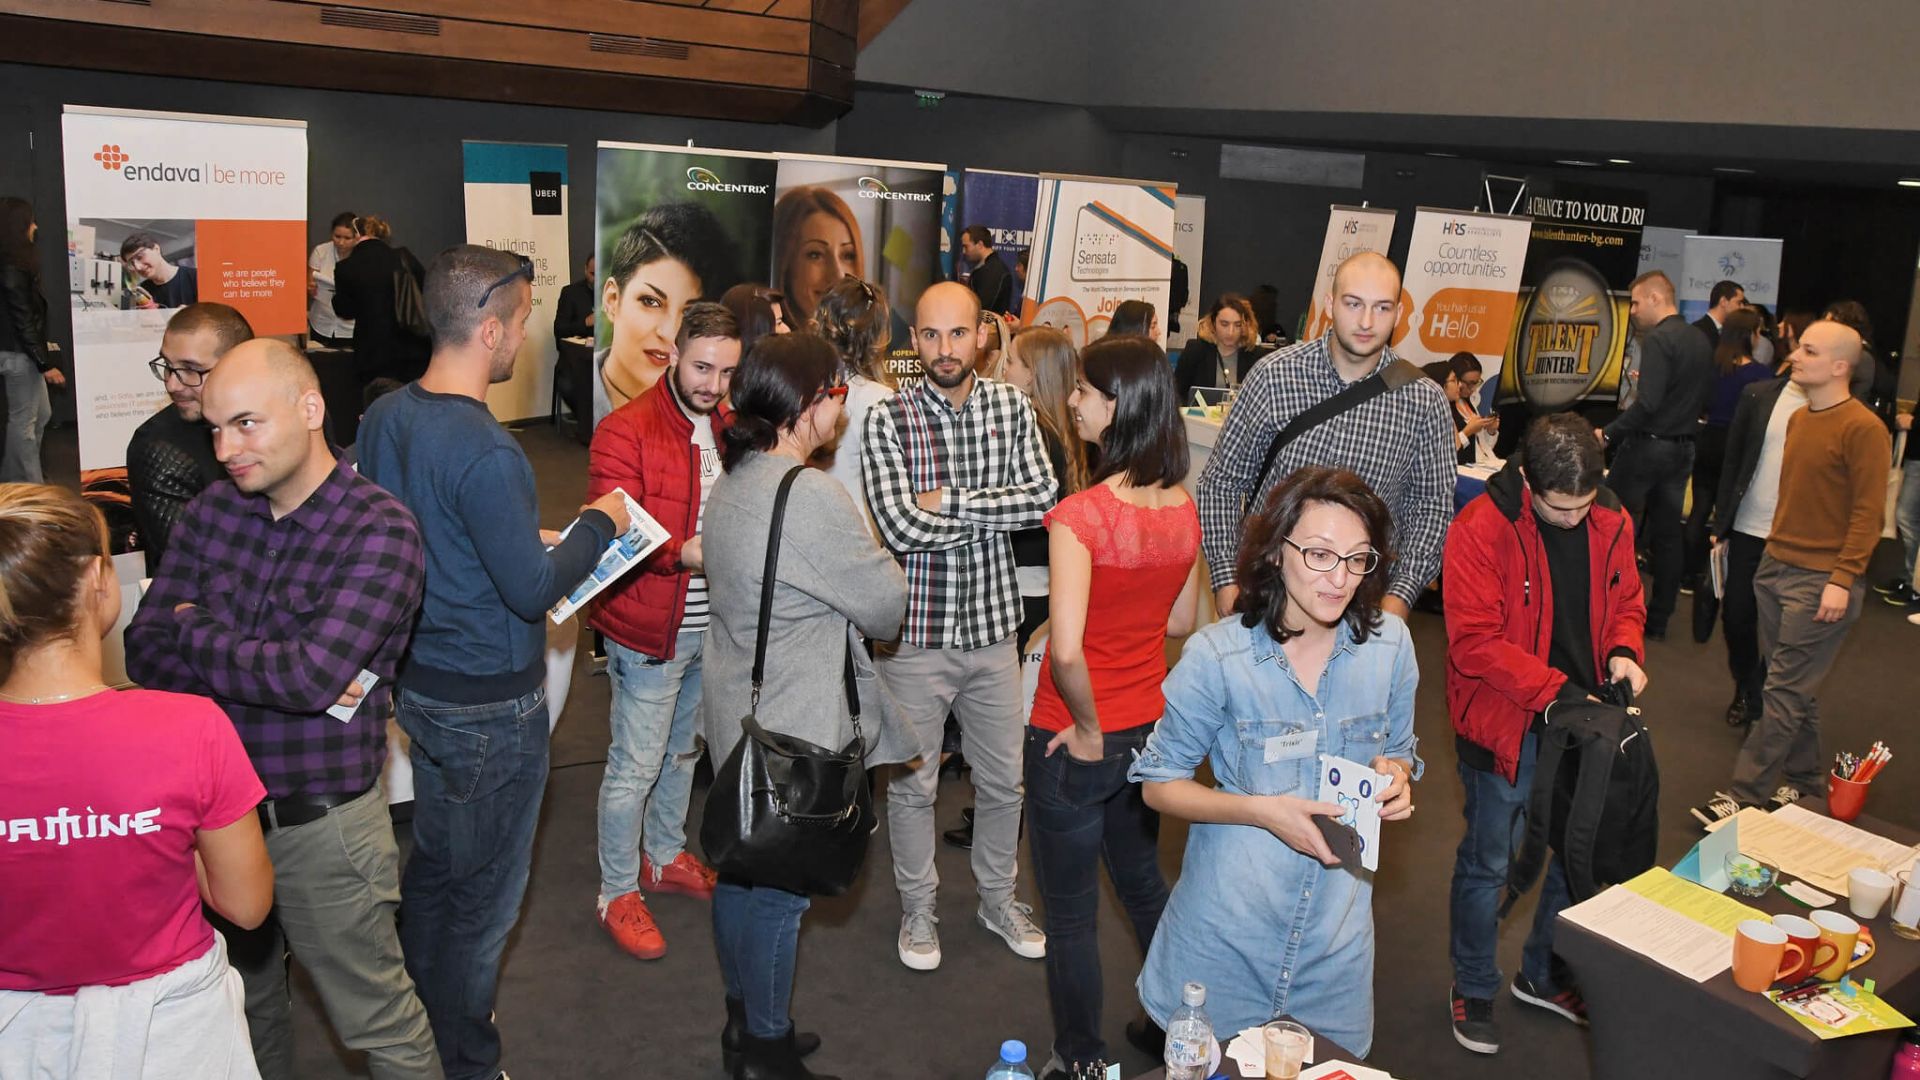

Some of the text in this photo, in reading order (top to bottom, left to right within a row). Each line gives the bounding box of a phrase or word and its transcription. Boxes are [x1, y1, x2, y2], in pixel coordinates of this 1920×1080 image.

[124, 163, 285, 185] endava be more
[535, 189, 557, 198] UBER
[687, 182, 768, 194] CONCENTRIX
[858, 190, 933, 202] CONCENTRIX
[1527, 197, 1645, 226] A CHANCE TO YOUR DRI
[1078, 250, 1117, 265] Sensata
[1439, 242, 1498, 262] Countless
[251, 268, 277, 278] people
[1424, 260, 1507, 278] opportunities
[223, 279, 285, 288] who believe they
[223, 290, 238, 298] can
[240, 289, 250, 297] be
[1436, 303, 1450, 312] You
[1451, 302, 1468, 313] had
[1430, 314, 1479, 339] Hello
[1525, 323, 1600, 376] TALENT
[1536, 356, 1575, 374] HUNTER
